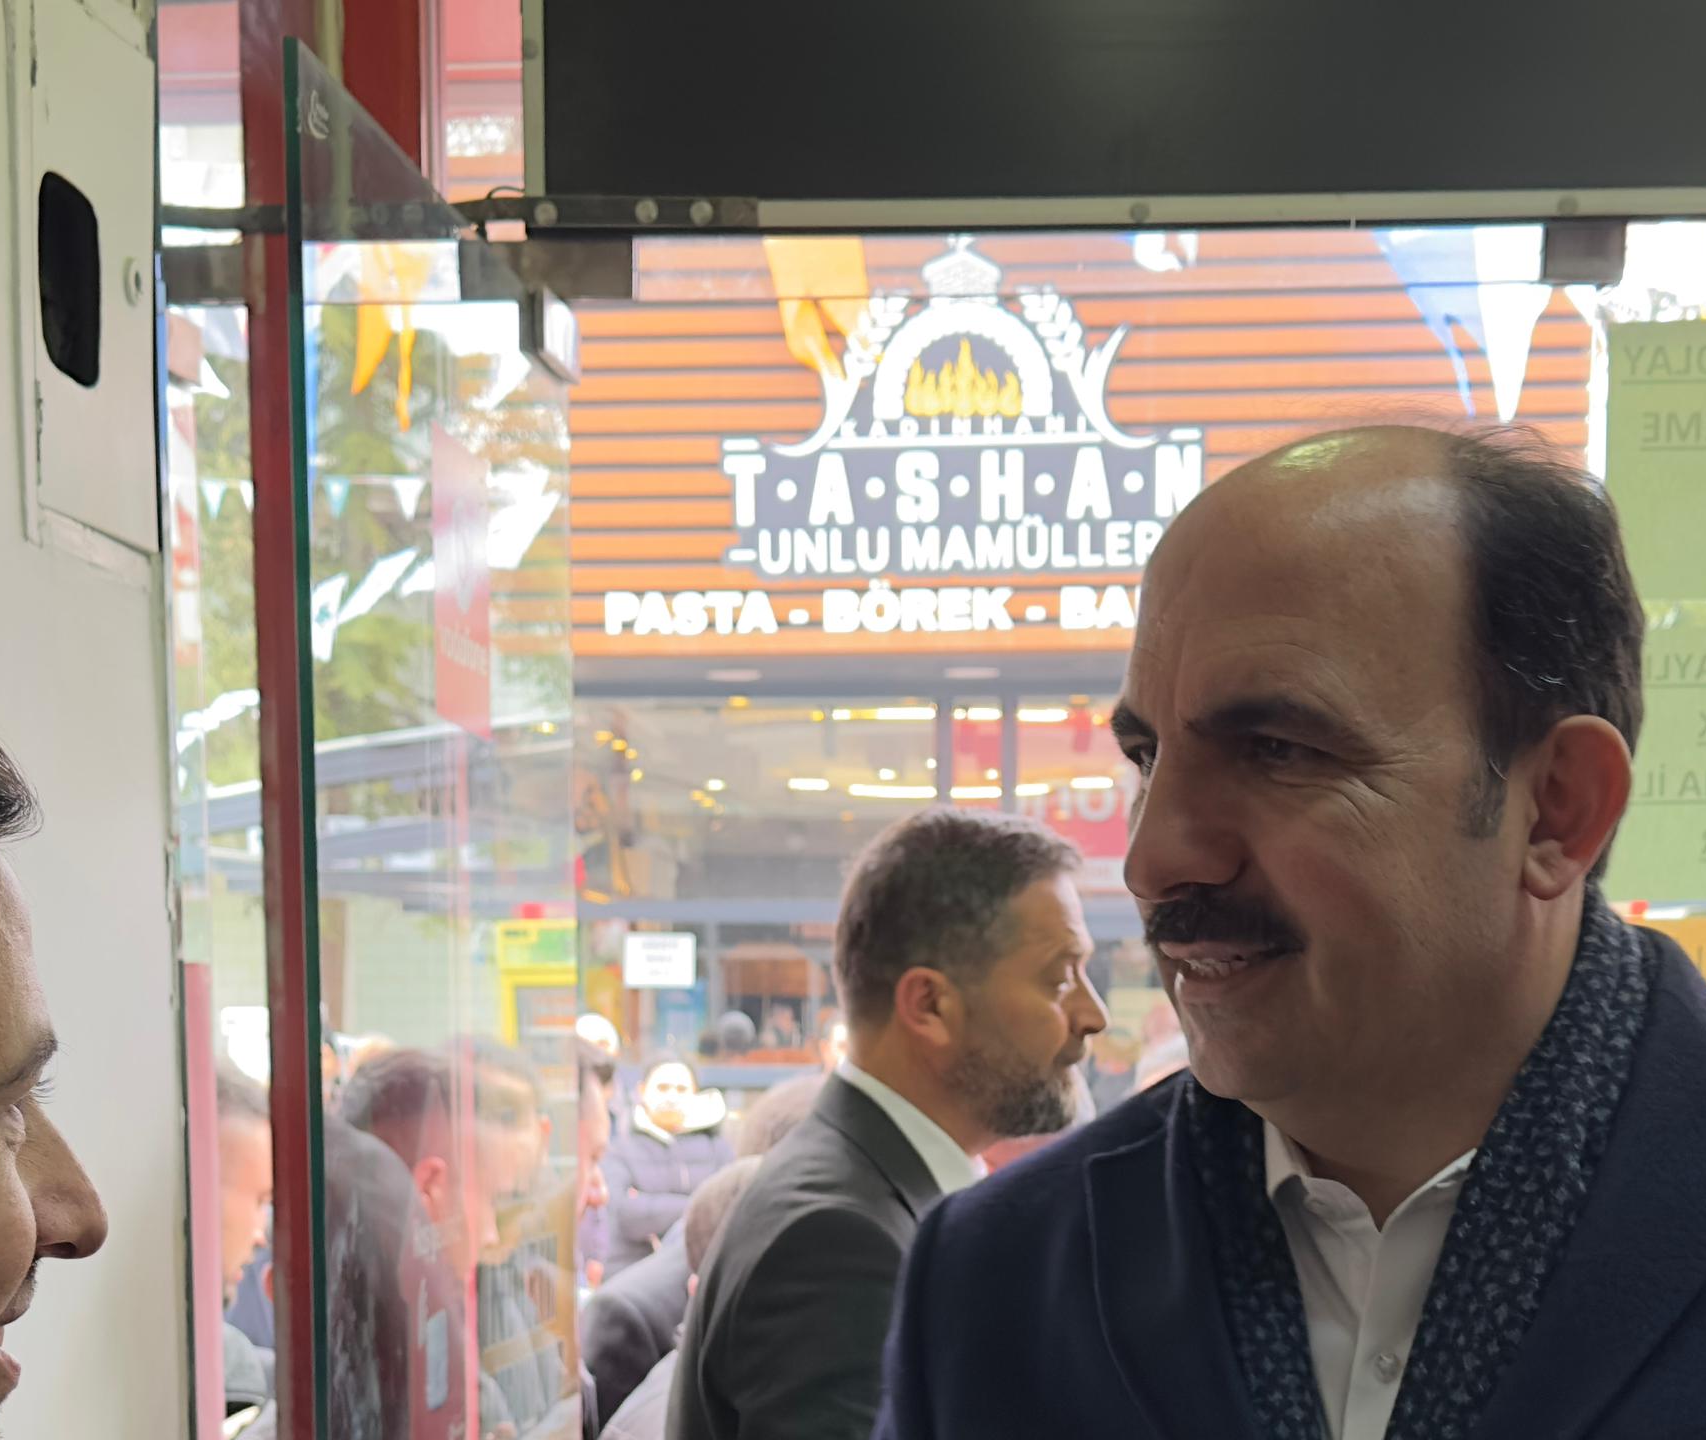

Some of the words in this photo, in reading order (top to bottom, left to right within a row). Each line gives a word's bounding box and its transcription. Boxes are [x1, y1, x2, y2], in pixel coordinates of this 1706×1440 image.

[604, 590, 778, 637] PASTA
[822, 579, 1014, 634] BÖREK
[1059, 585, 1142, 631] BA
